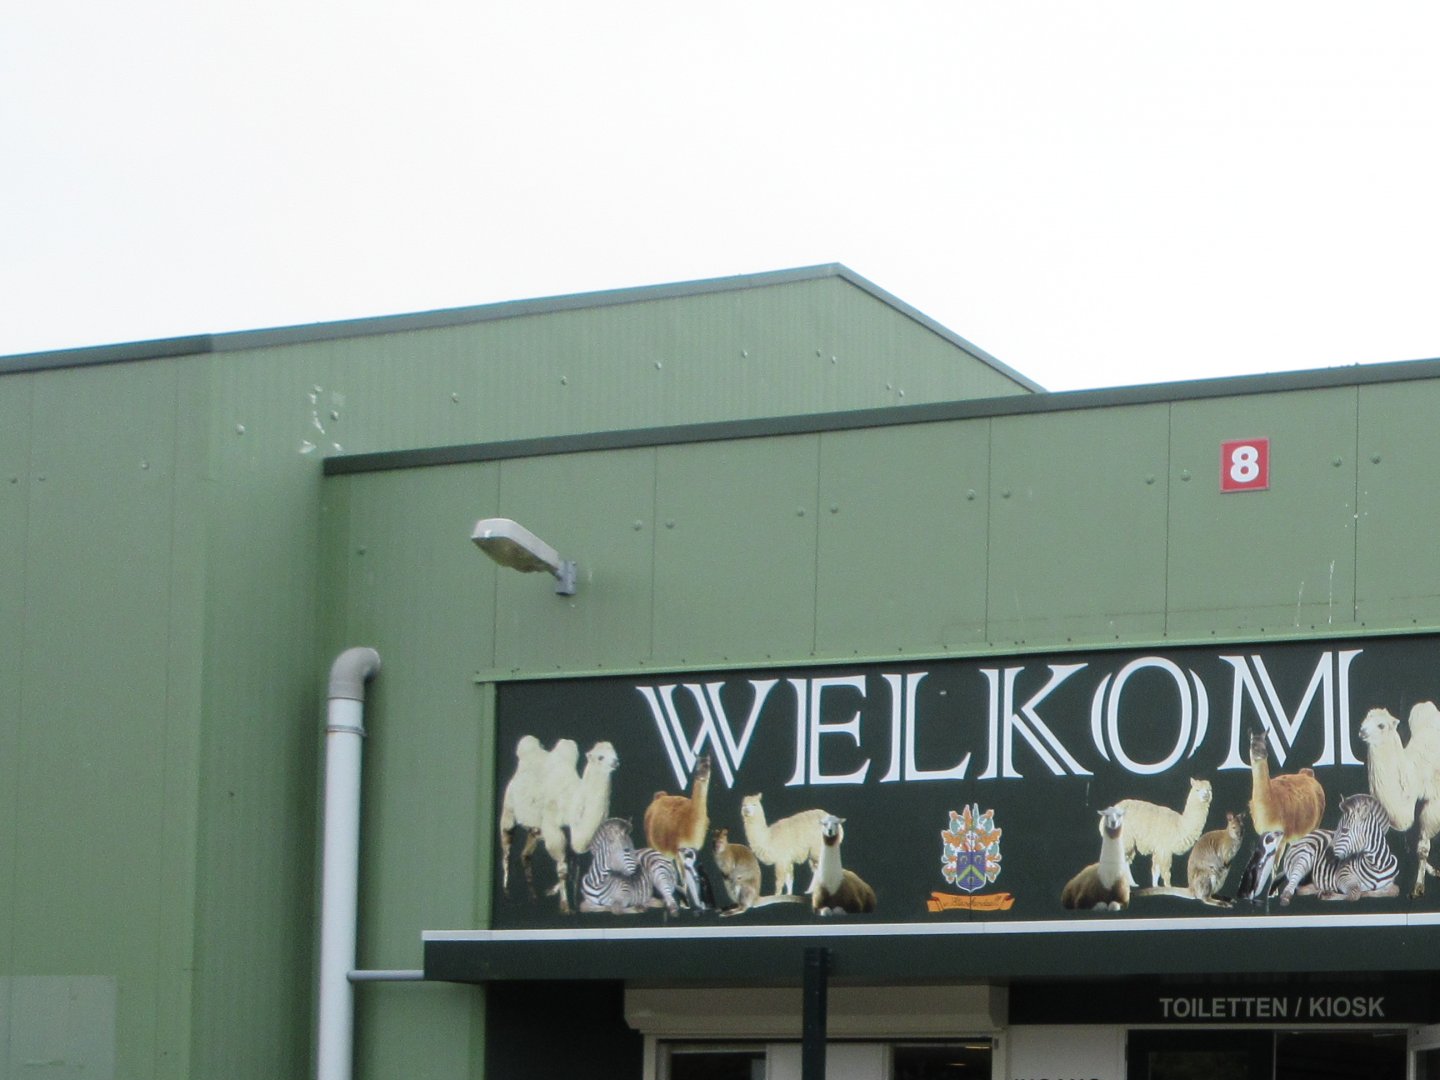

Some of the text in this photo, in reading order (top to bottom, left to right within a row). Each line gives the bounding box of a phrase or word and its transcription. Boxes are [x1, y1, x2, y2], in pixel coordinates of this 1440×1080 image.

[1230, 445, 1260, 483] 8
[635, 649, 1365, 790] WELKOM
[1159, 997, 1288, 1018] TOILETTEN
[1309, 996, 1386, 1018] KIOSK
